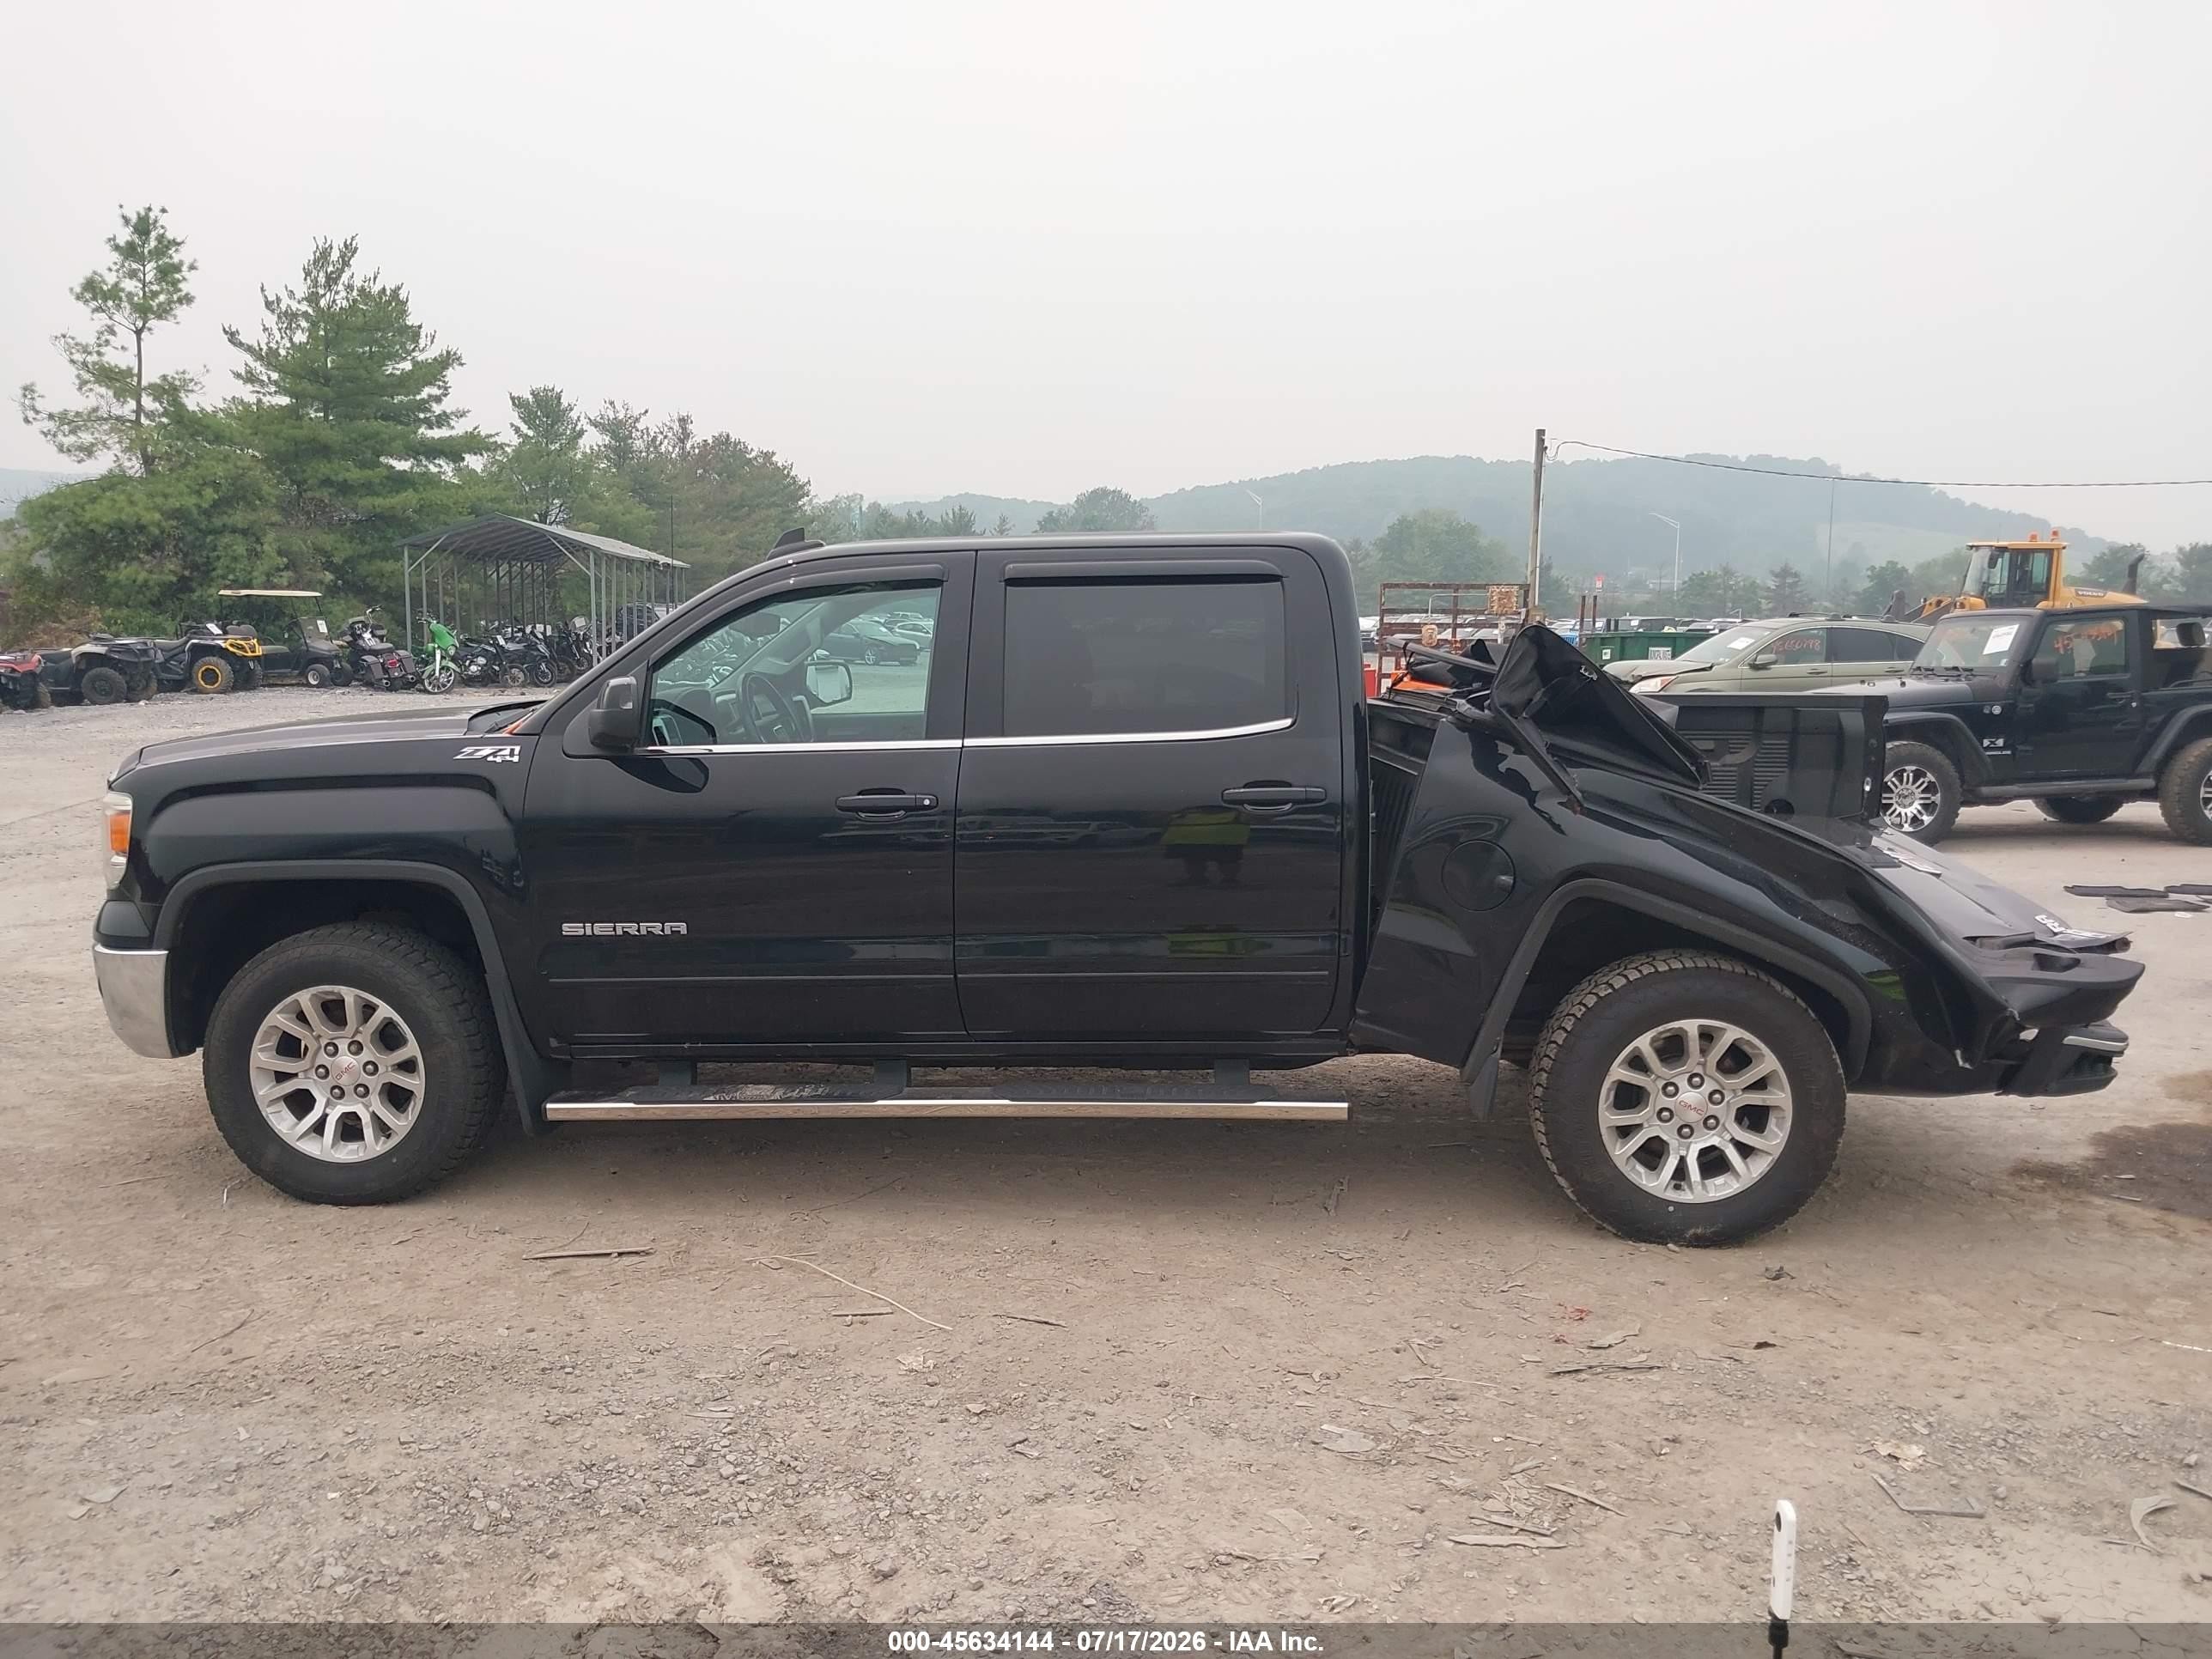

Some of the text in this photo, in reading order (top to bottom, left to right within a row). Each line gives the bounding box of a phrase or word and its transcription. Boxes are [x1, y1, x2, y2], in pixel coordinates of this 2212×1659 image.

[453, 745, 522, 760] Z71
[561, 922, 688, 937] SIERRA
[335, 1060, 356, 1080] GMC
[1679, 1099, 1705, 1116] GMC
